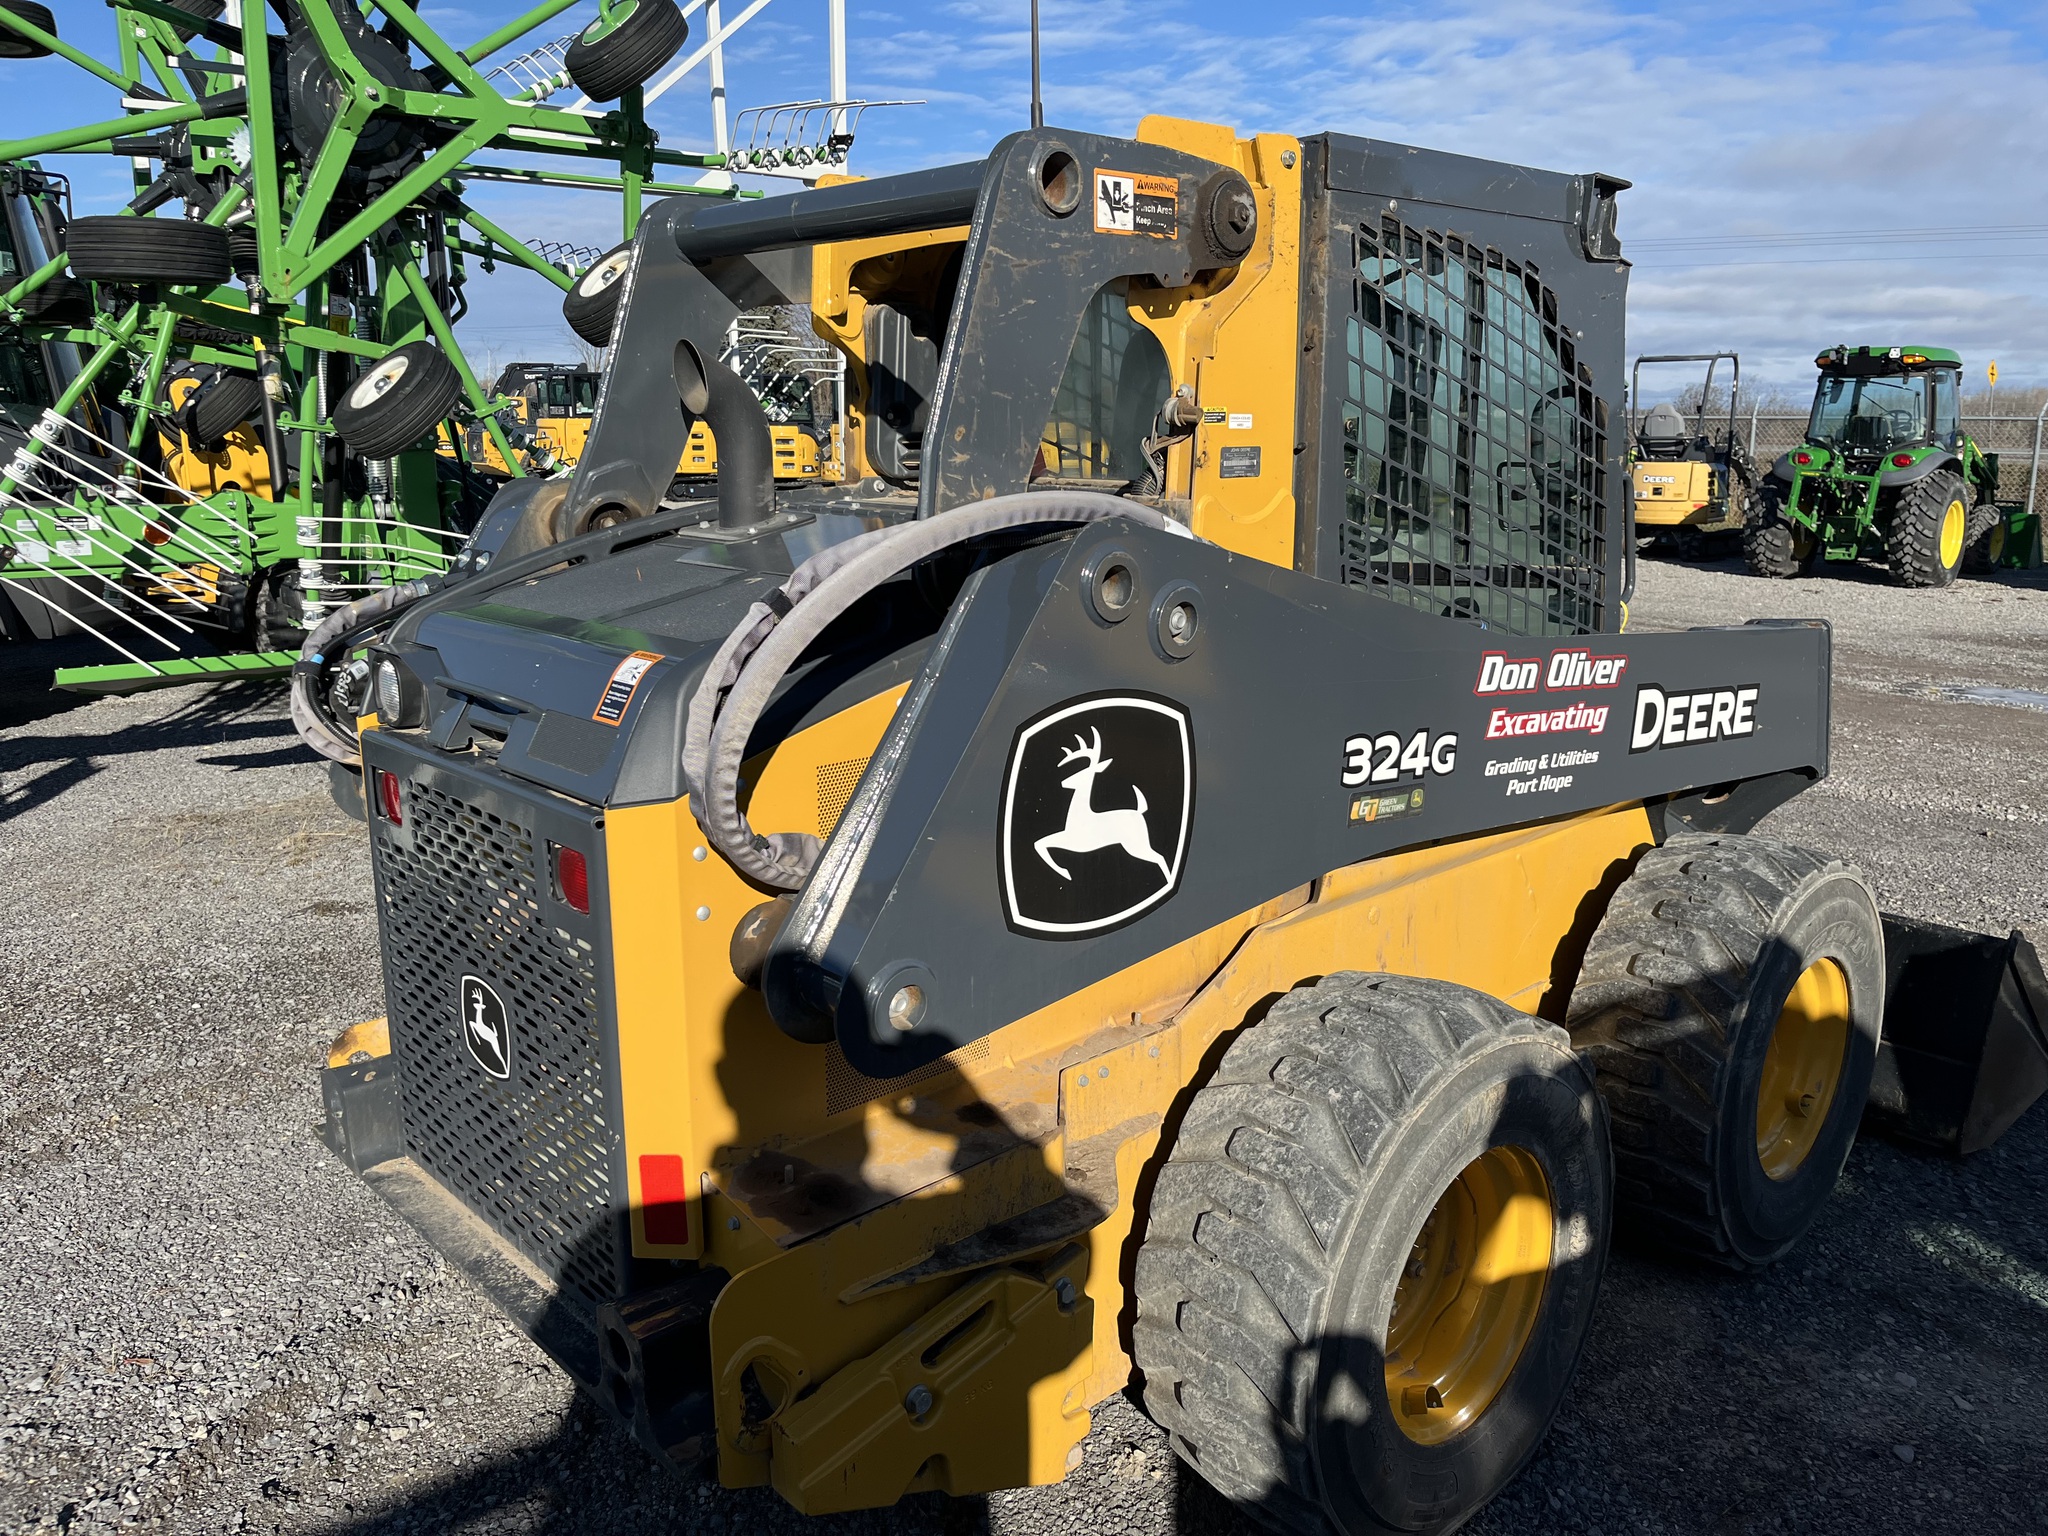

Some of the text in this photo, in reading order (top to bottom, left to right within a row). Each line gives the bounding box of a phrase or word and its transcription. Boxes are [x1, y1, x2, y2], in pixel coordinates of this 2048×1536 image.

[1143, 181, 1175, 194] WARNING
[1157, 204, 1173, 215] Area
[1136, 215, 1151, 226] Keep
[1642, 475, 1676, 483] DEERE
[1476, 651, 1627, 693] Don Oliver
[1486, 702, 1610, 738] Excavating
[1630, 687, 1758, 750] DEERE
[1341, 730, 1458, 786] 324G
[1484, 749, 1600, 776] Grading & Utilities
[1505, 774, 1573, 796] Port Hope
[1378, 802, 1406, 815] TRACTORS
[1379, 797, 1394, 807] GREEN
